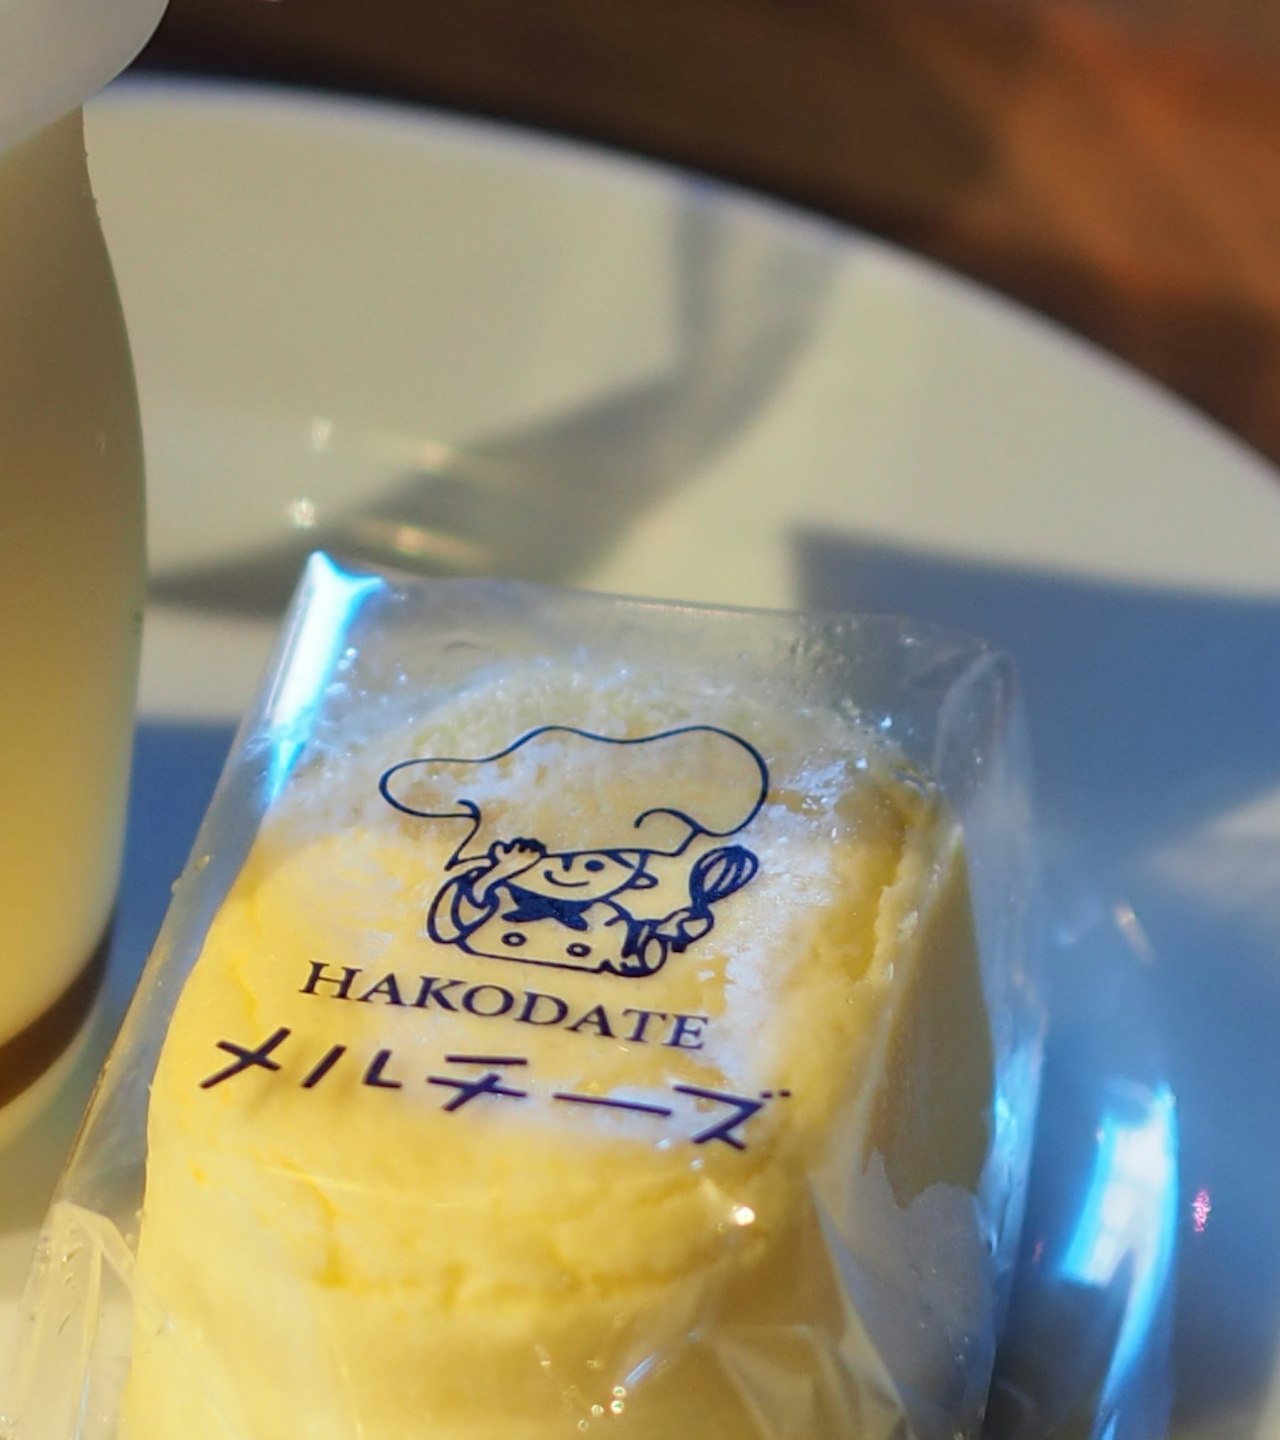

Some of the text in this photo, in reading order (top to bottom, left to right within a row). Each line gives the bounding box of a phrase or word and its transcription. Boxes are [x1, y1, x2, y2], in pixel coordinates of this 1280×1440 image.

[298, 960, 711, 1050] HAKODATE
[198, 1026, 792, 1151] メルチーズ
